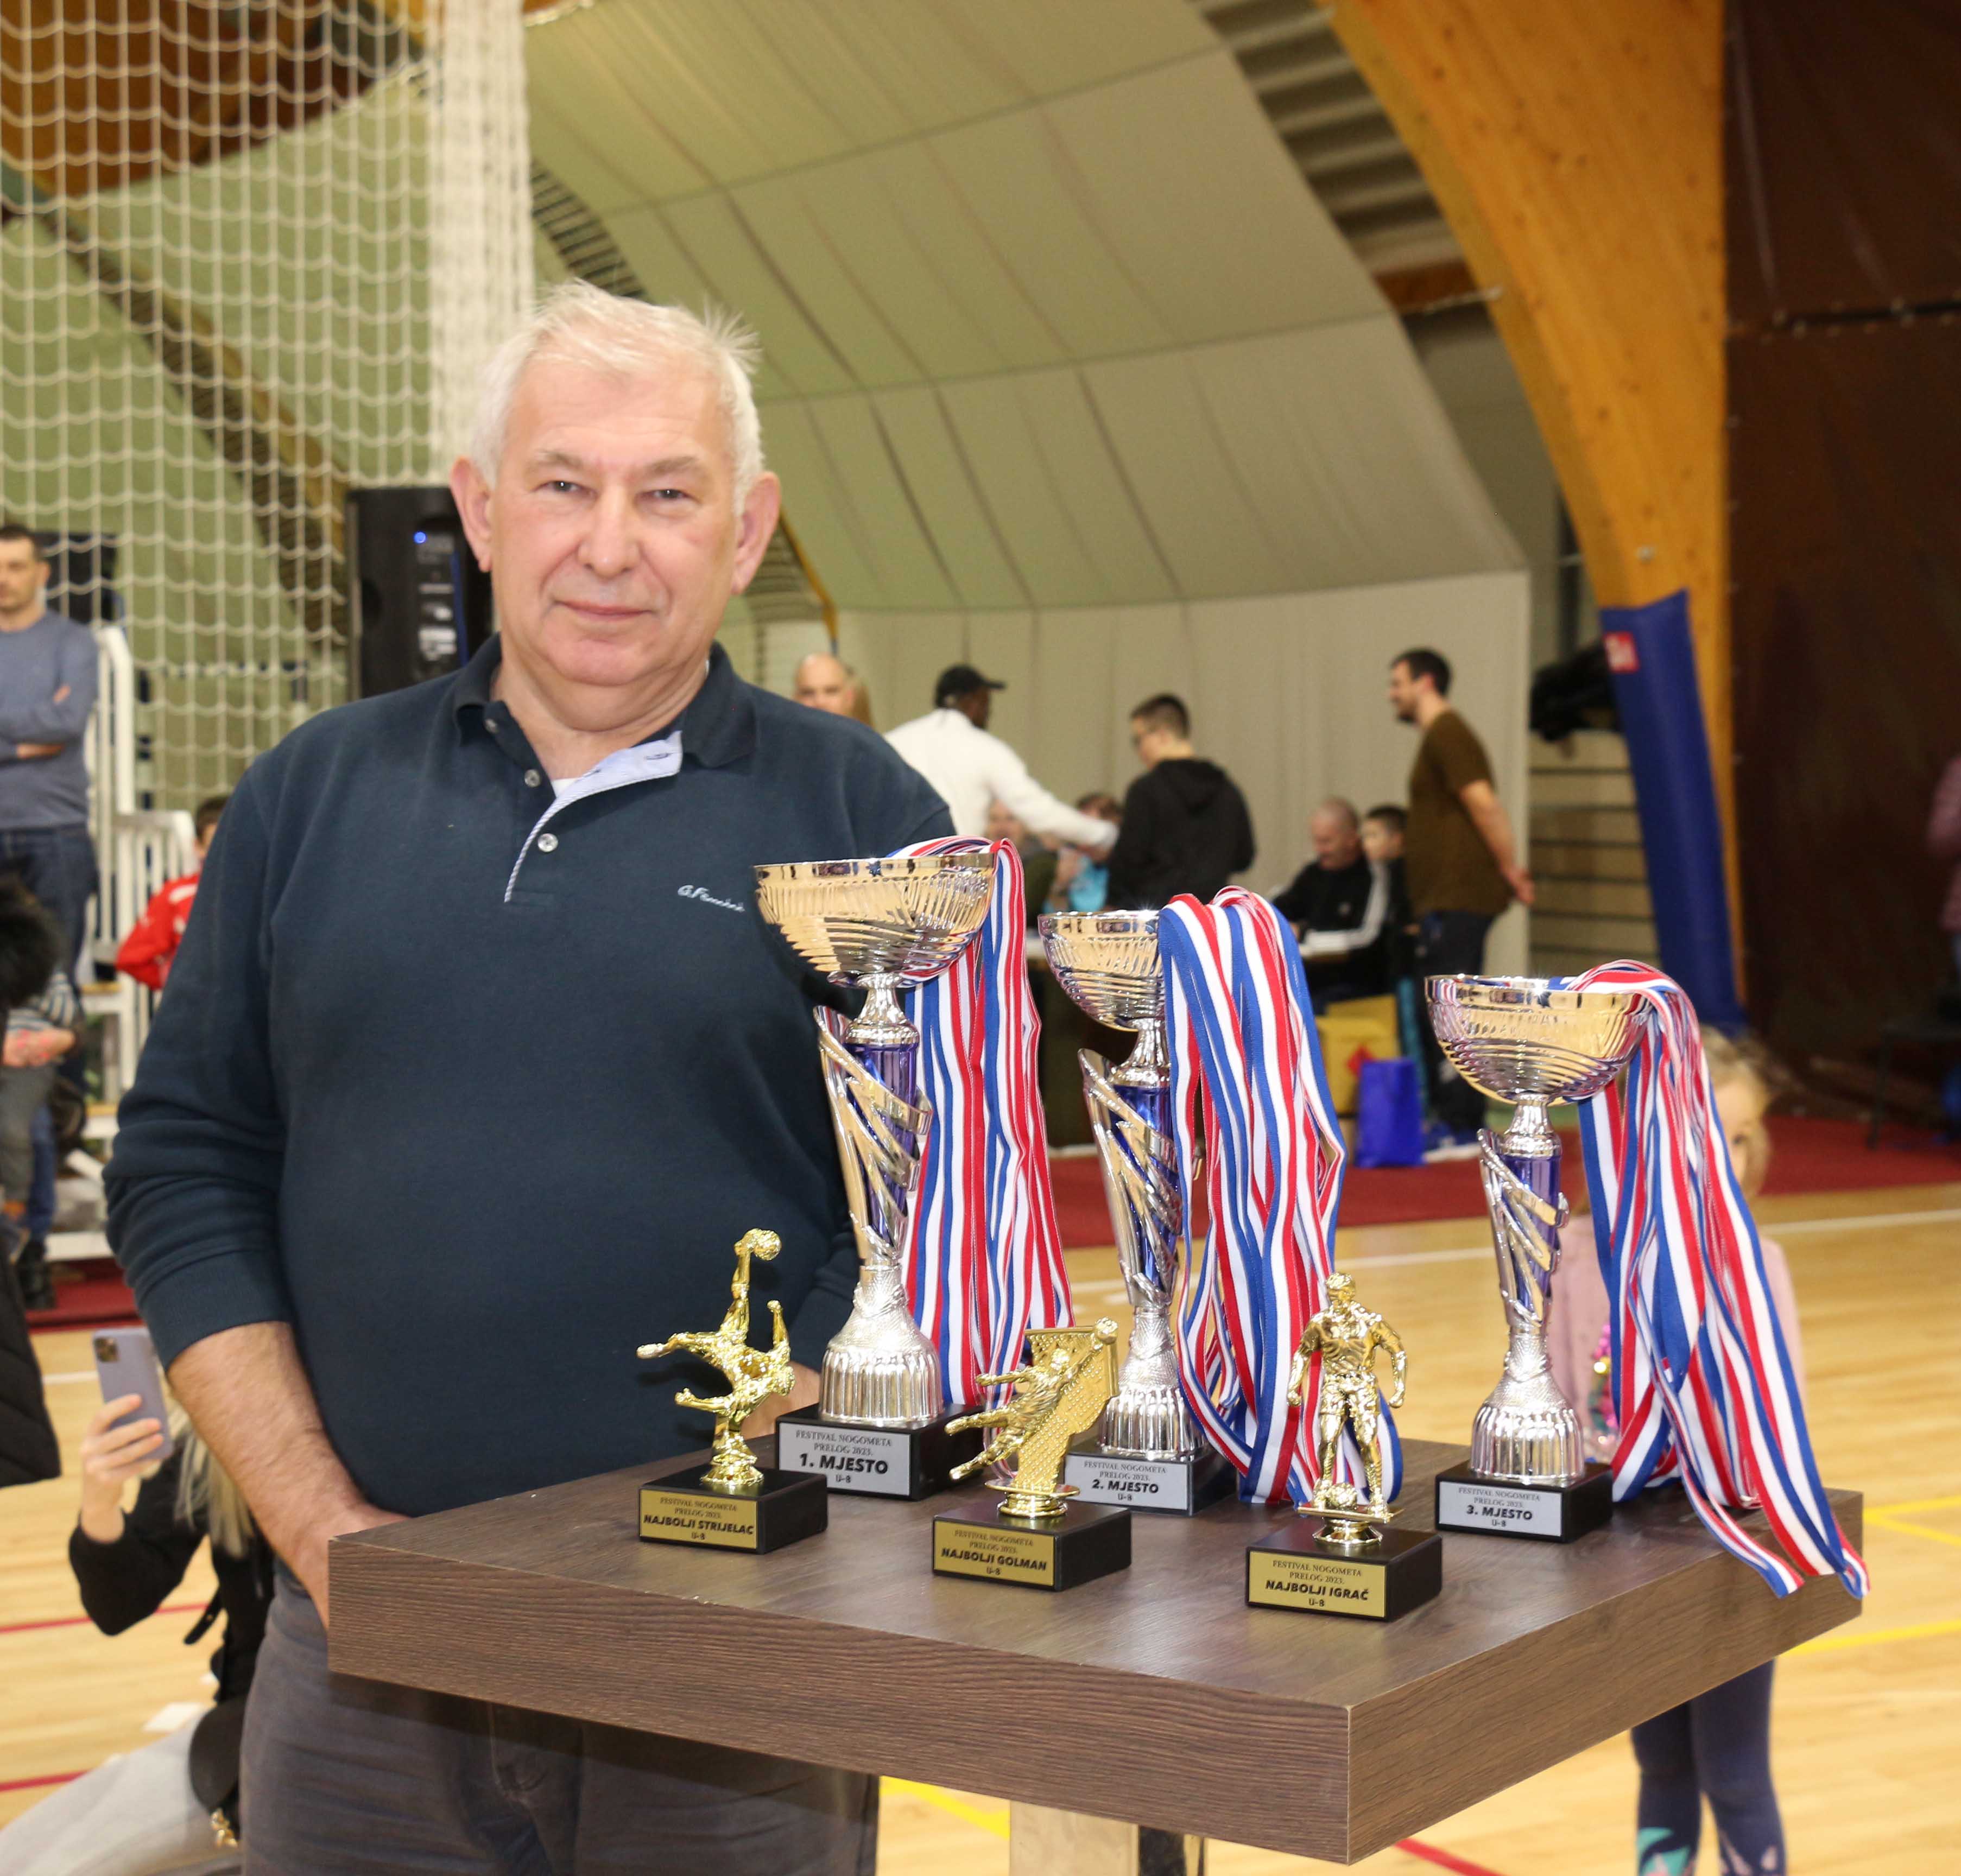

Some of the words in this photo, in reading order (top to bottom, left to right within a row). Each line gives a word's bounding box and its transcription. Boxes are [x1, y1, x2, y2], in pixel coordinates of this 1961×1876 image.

[796, 1430, 837, 1441] FESTIVAL
[839, 1435, 891, 1447] NOGOMETA
[814, 1443, 850, 1454] PRELOG
[852, 1447, 874, 1456] 2023.
[800, 1453, 814, 1467] 1.
[820, 1455, 888, 1474] MJESTO
[1084, 1461, 1117, 1469] FESTIVAL
[1121, 1464, 1166, 1473] NOGOMETA
[836, 1475, 851, 1483] U-8
[1099, 1471, 1130, 1479] PRELOG
[1092, 1479, 1103, 1489] 2.
[1108, 1481, 1158, 1493] MJESTO
[1459, 1487, 1492, 1496] FESTIVAL
[1495, 1491, 1540, 1501] NOGOMETA
[1467, 1505, 1478, 1514] 3.
[1482, 1507, 1532, 1520] MJESTO
[643, 1515, 694, 1528] NAJBOLJI
[699, 1522, 754, 1535] STRIJELAC
[941, 1549, 994, 1563] NAJBOLJI
[998, 1556, 1047, 1570] GOLMAN
[1273, 1561, 1310, 1570] FESTIVAL
[1313, 1565, 1362, 1576] NOGOMETA
[1289, 1571, 1323, 1581] PRELOG
[1325, 1576, 1344, 1585] 2023.
[1266, 1580, 1326, 1595] NAJBOLJI
[1329, 1587, 1369, 1600] IGRAČ
